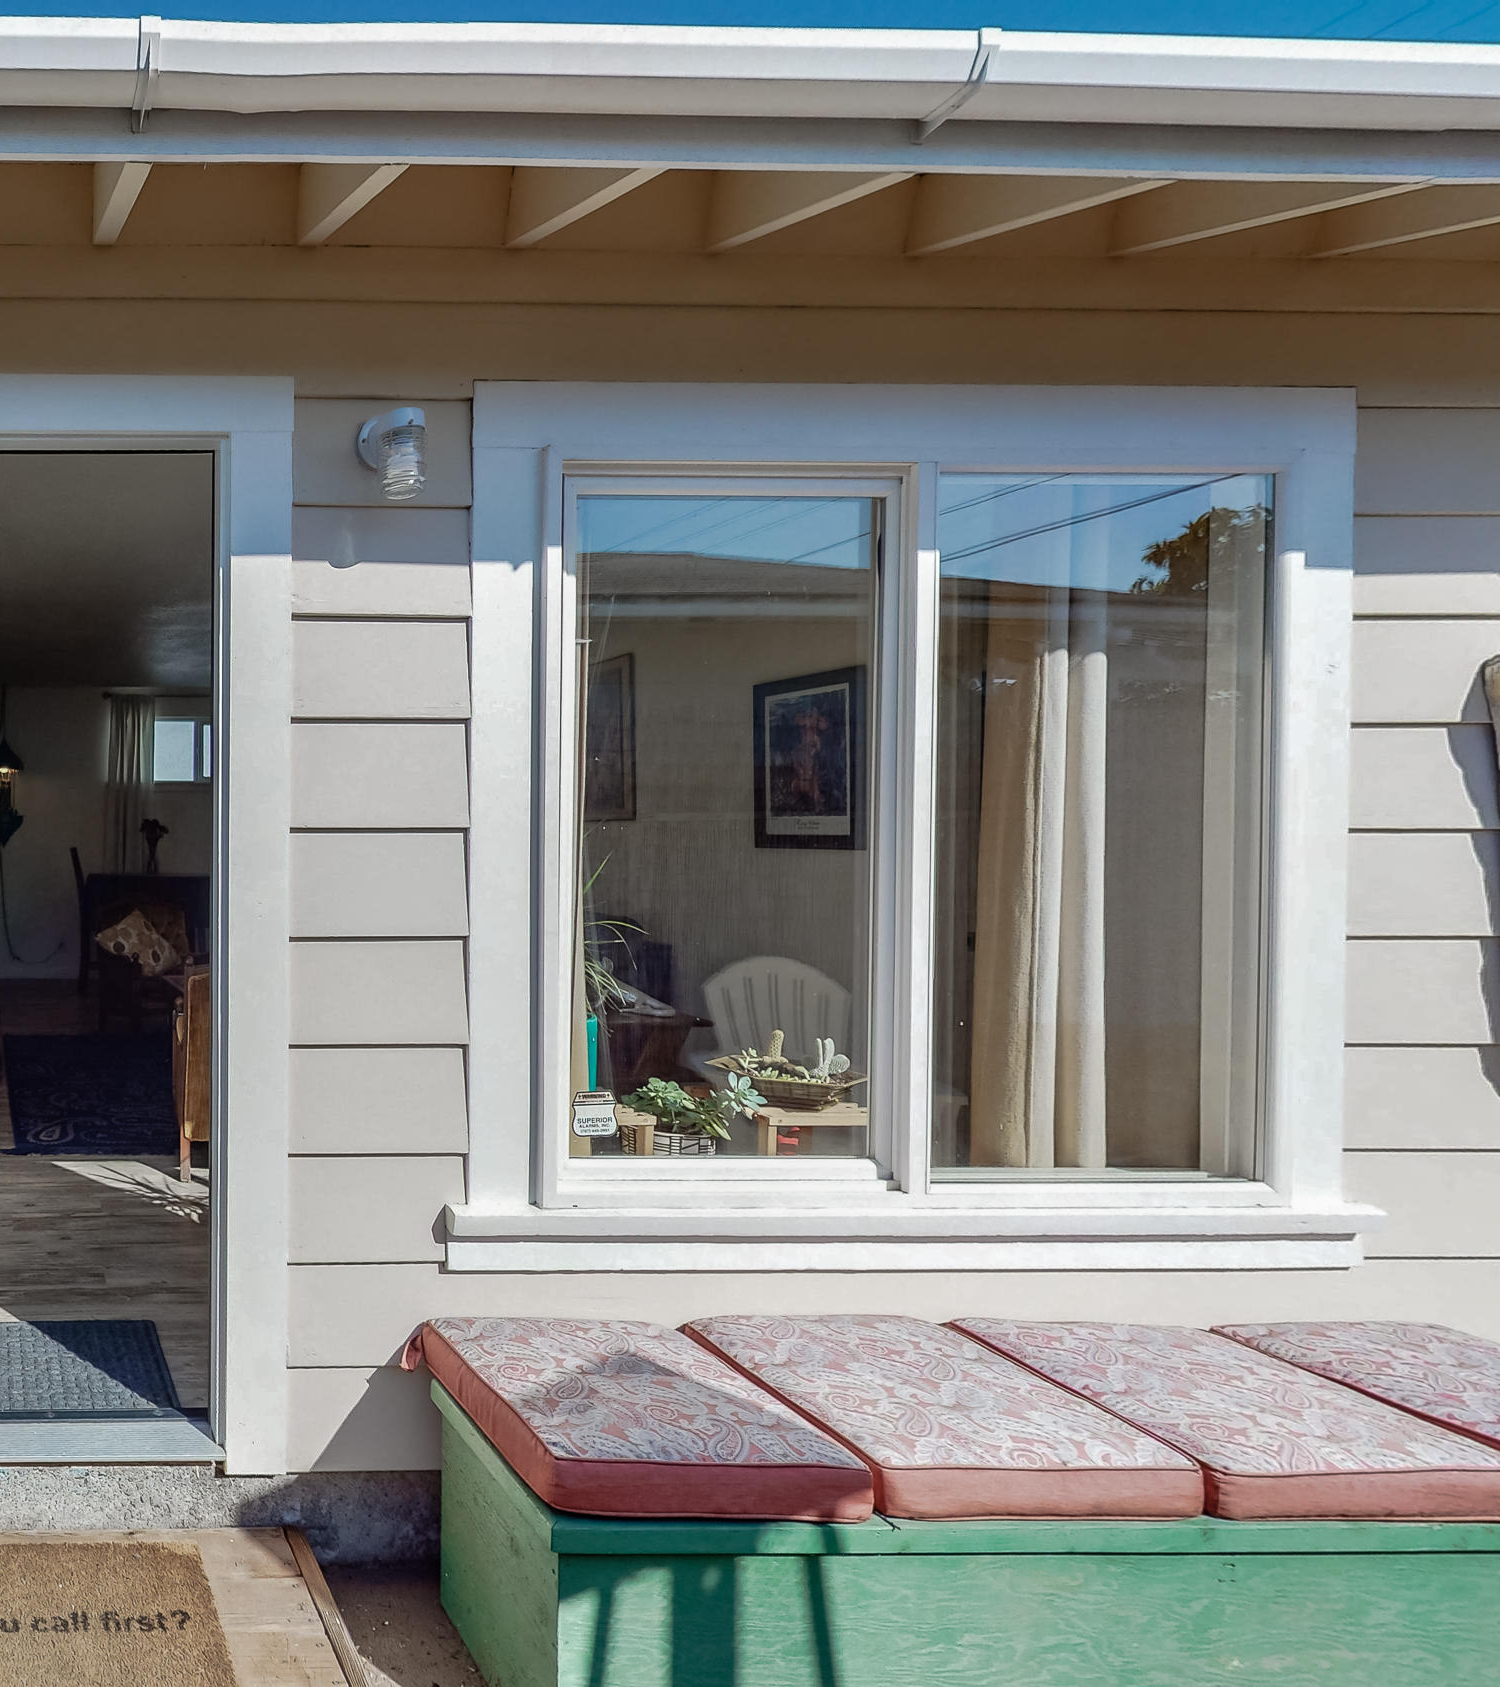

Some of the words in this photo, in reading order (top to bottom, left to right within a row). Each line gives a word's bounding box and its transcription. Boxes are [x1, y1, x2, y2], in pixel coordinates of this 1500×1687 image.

[577, 1116, 613, 1124] SUPERIOR
[30, 1610, 90, 1633] call
[100, 1609, 191, 1633] first?
